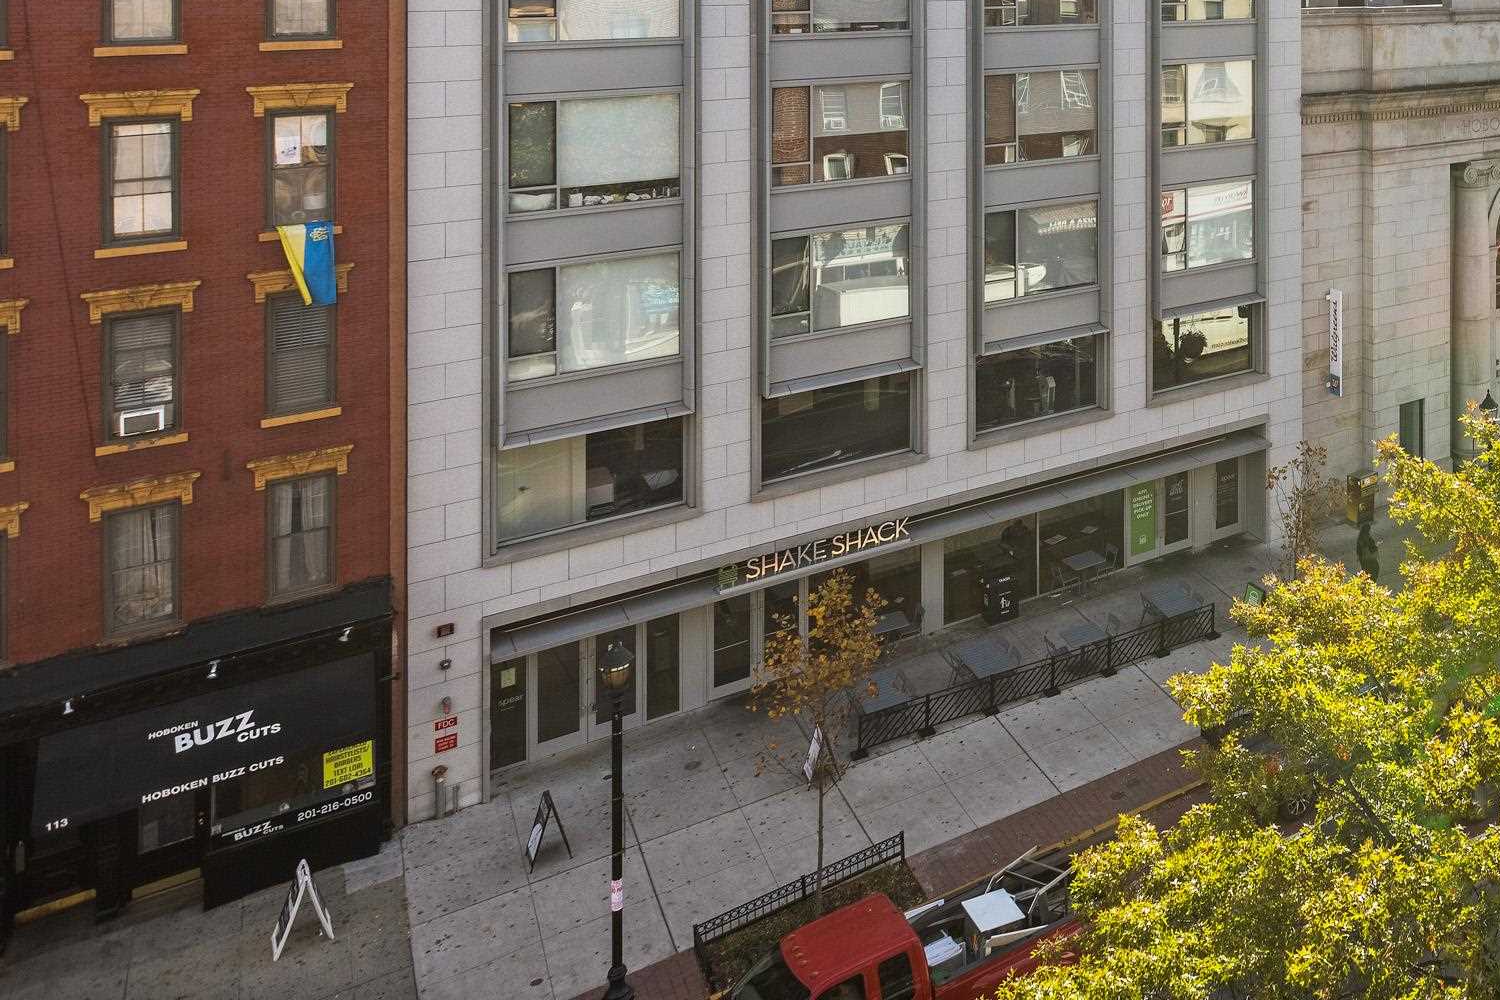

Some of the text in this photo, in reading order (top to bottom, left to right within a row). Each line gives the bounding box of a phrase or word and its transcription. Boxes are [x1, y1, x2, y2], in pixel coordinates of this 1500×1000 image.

[1330, 300, 1339, 362] Walgreens
[745, 516, 909, 579] SHAKE SHACK
[148, 720, 199, 740] HOBOKEN
[174, 709, 256, 754] BUZZ
[237, 723, 282, 743] CUTS
[141, 755, 285, 804] HOBOKEN BUZZ CUTS
[297, 791, 373, 822] 201-216-0500
[45, 818, 68, 831] 113
[234, 820, 272, 842] BUZZ
[262, 824, 284, 836] CUTS
